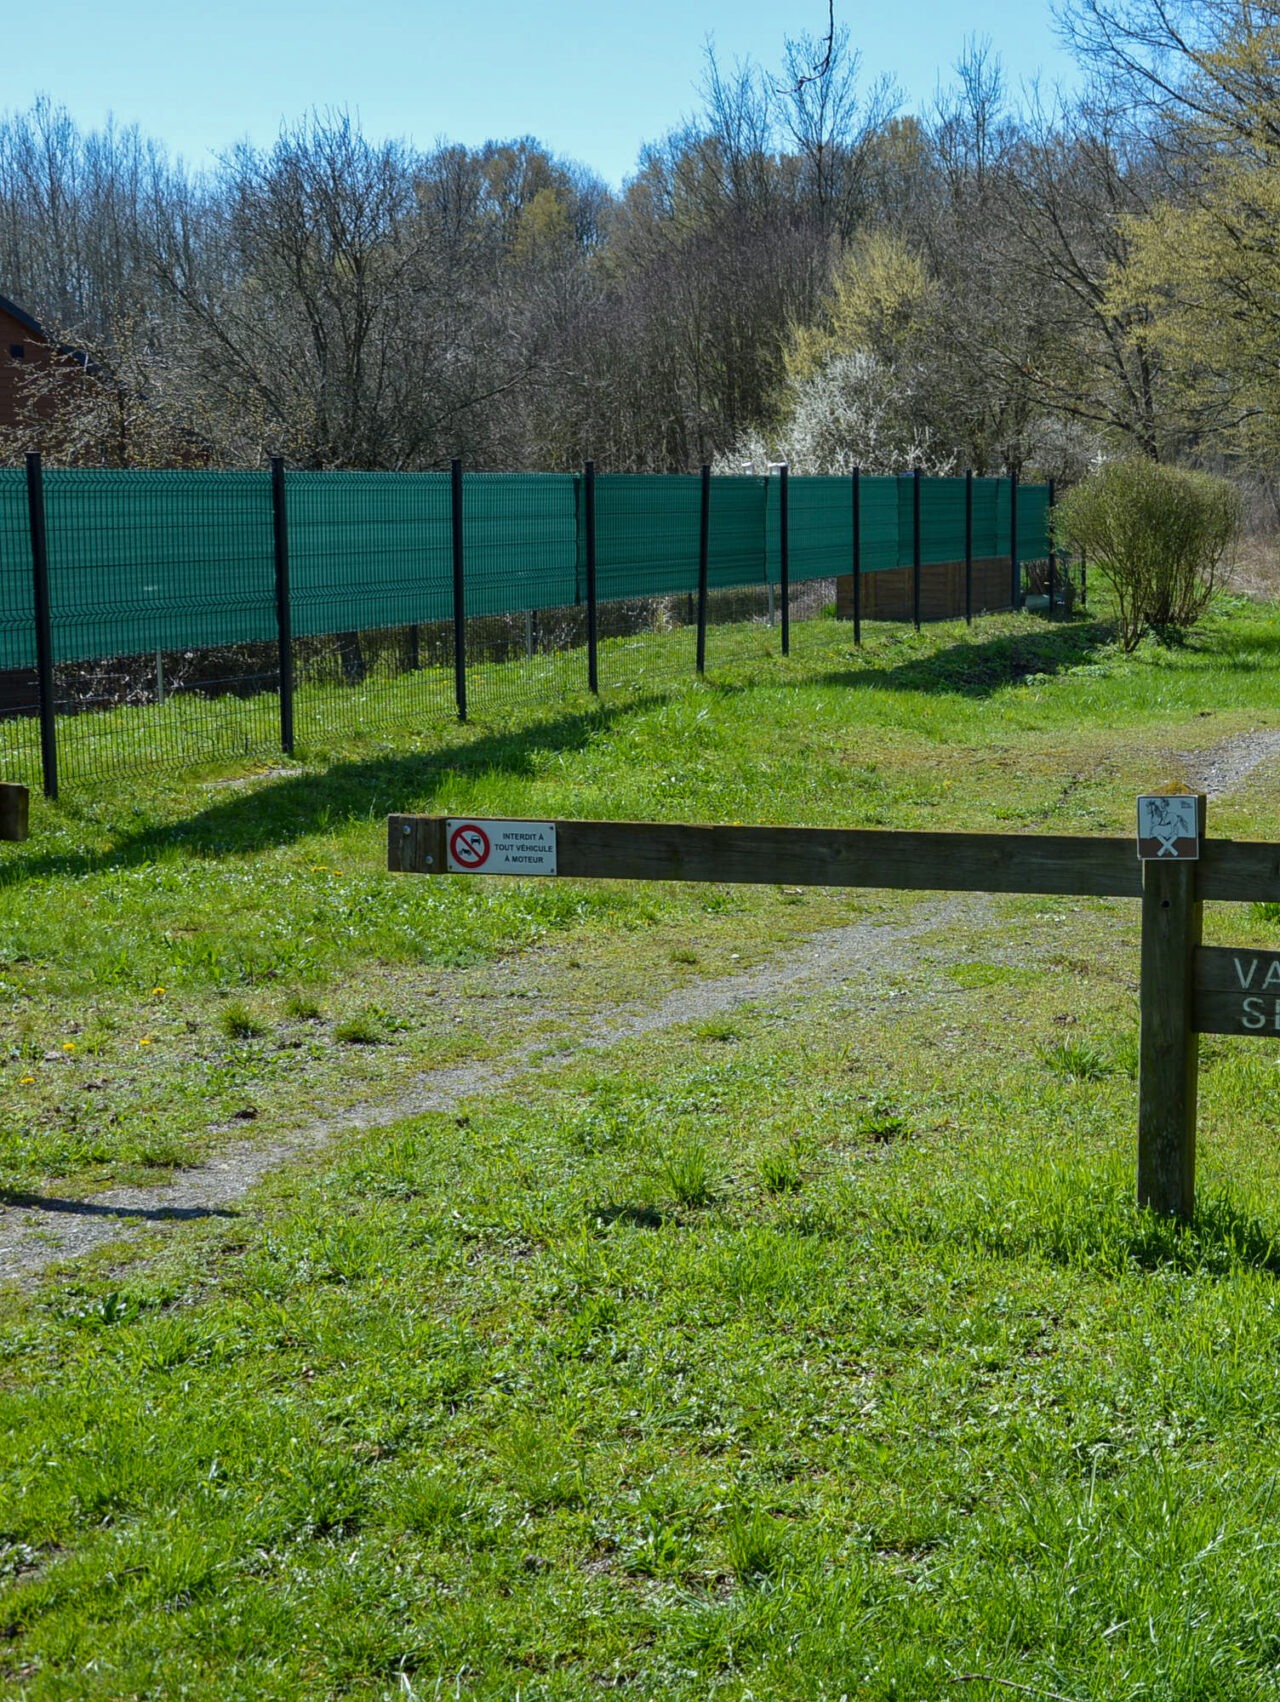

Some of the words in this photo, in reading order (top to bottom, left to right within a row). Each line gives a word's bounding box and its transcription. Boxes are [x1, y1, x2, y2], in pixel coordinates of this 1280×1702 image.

[503, 833, 537, 841] INTERDIT
[516, 844, 553, 852] VÉHICULE
[504, 854, 510, 862] À
